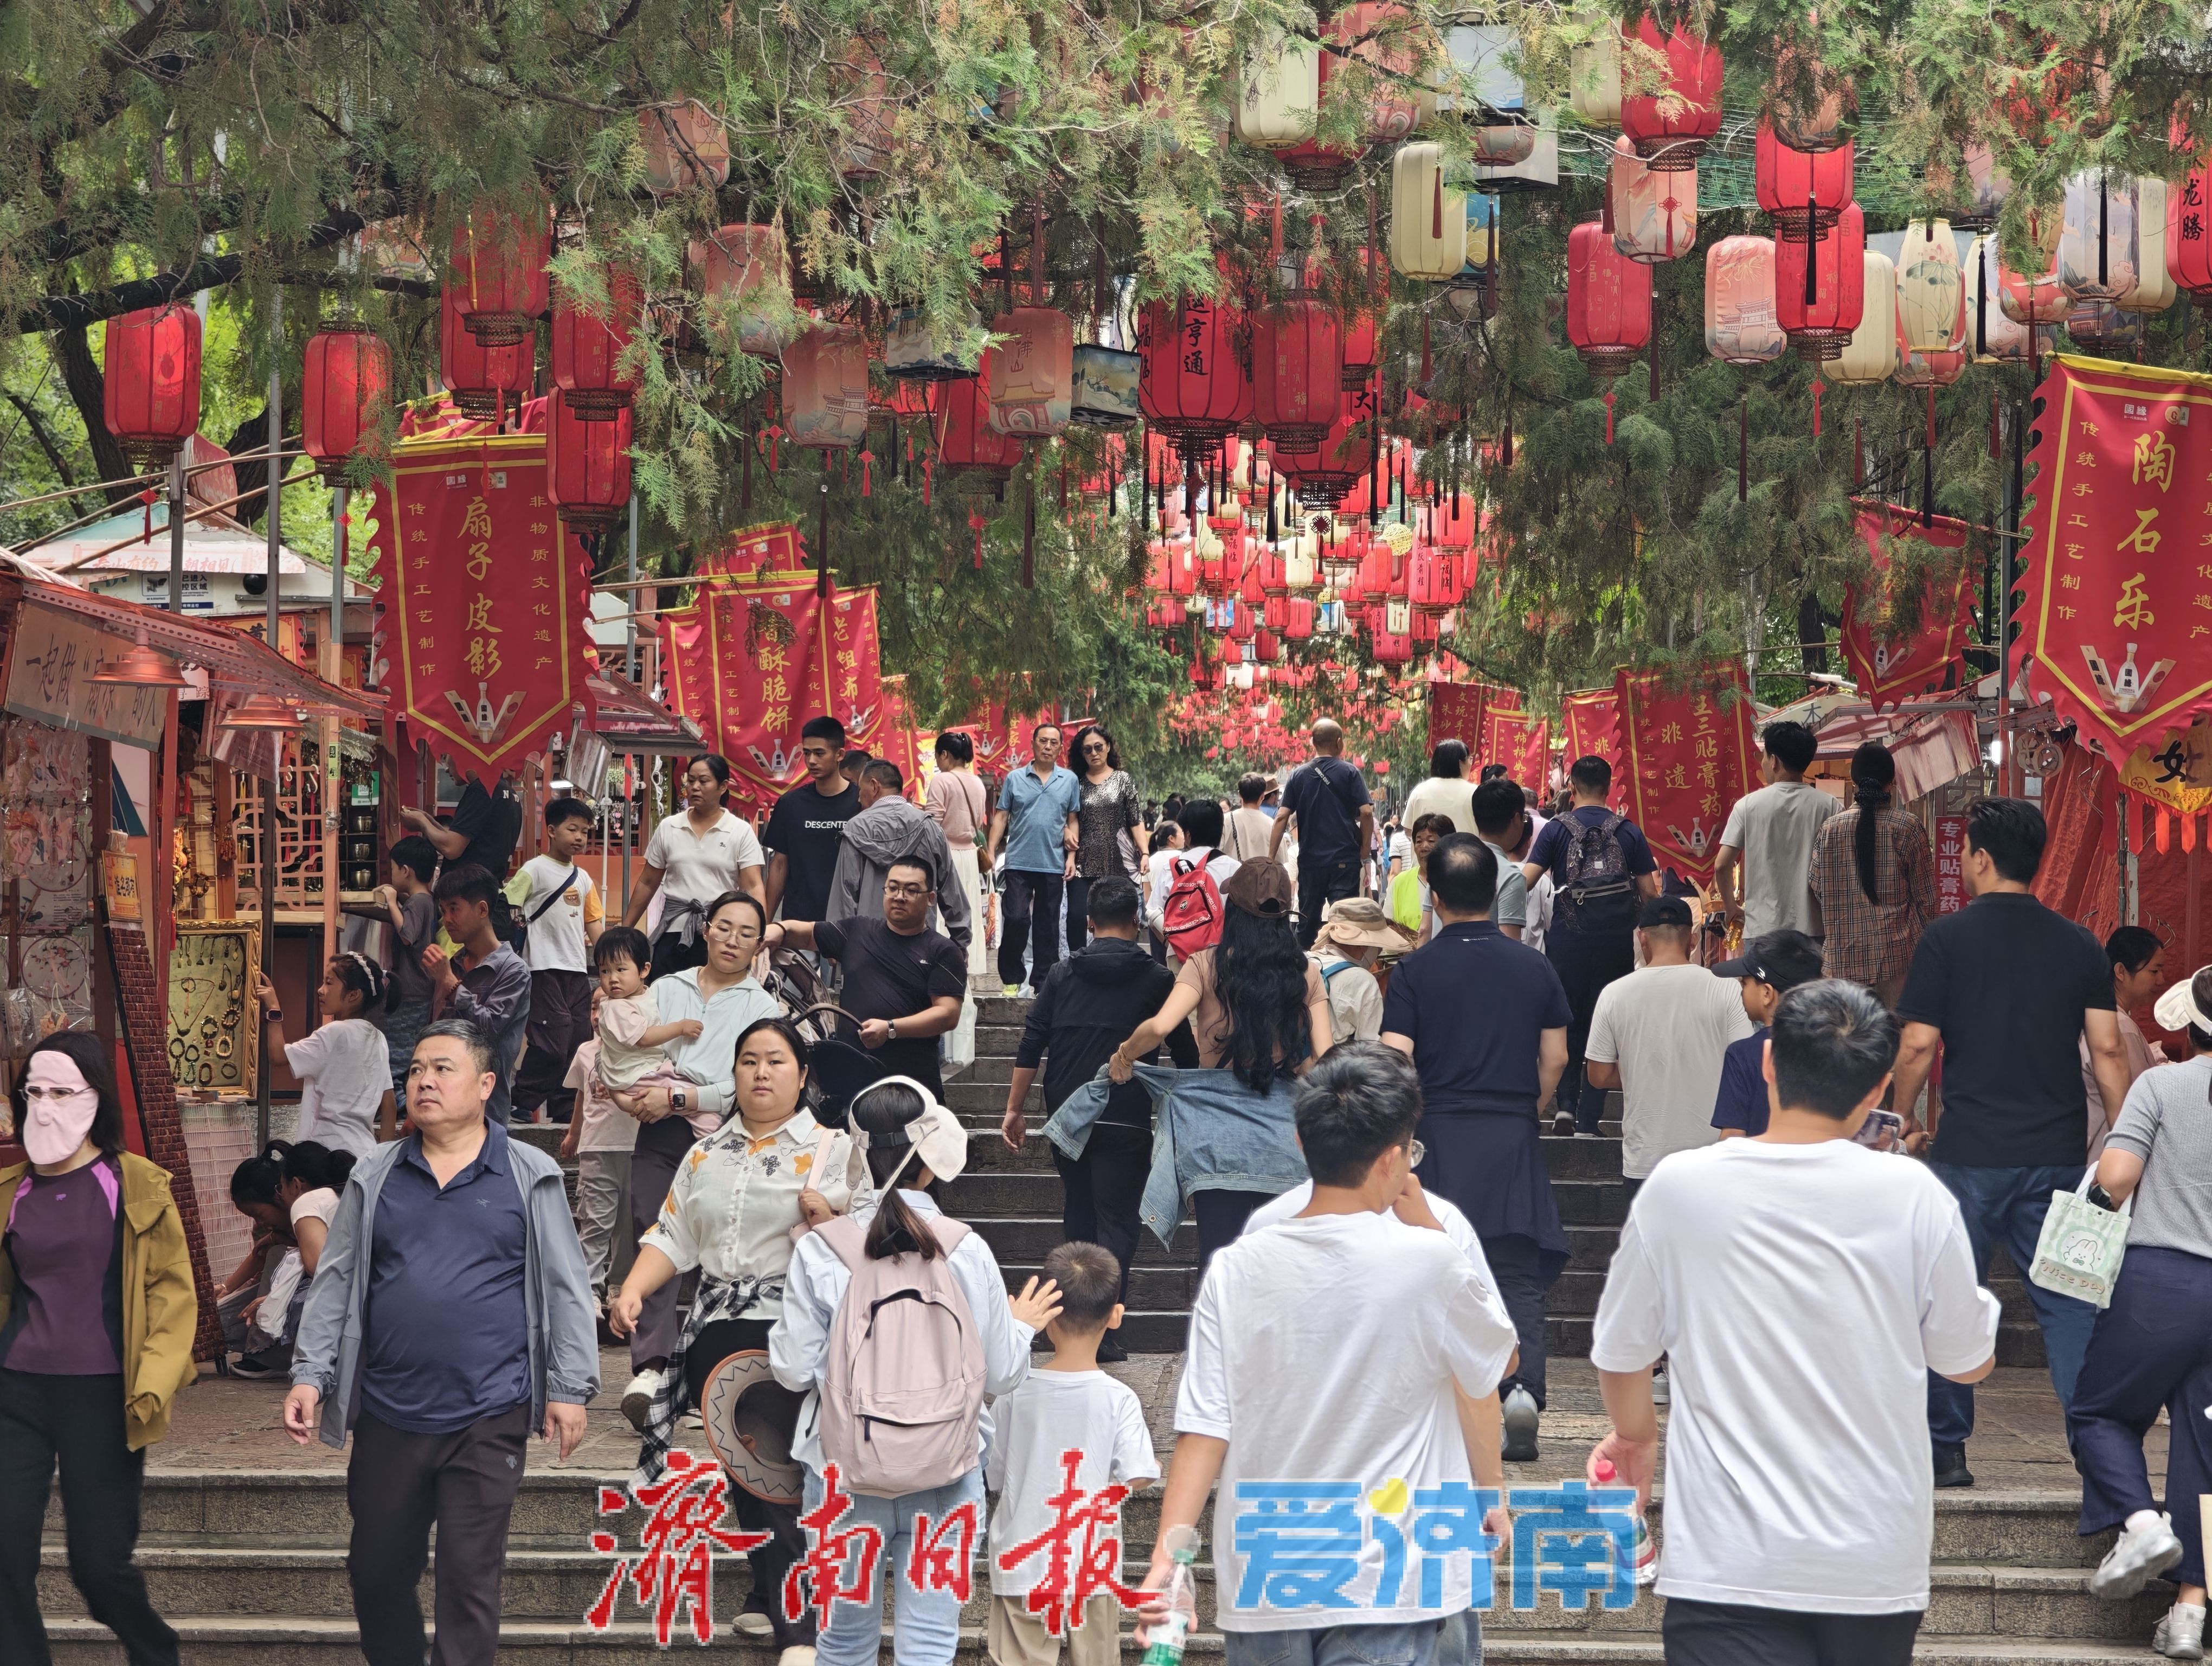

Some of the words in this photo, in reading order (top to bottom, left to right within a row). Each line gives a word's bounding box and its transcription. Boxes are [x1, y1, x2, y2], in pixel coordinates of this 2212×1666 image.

[407, 502, 436, 677] 传统手工艺制作
[457, 496, 503, 680] 扇子皮影
[529, 495, 553, 670] 非物质文化遗产
[2057, 421, 2100, 620] 传统手工艺制作
[2113, 431, 2176, 631] 陶石乐
[1939, 821, 1961, 913] 专业贴膏药
